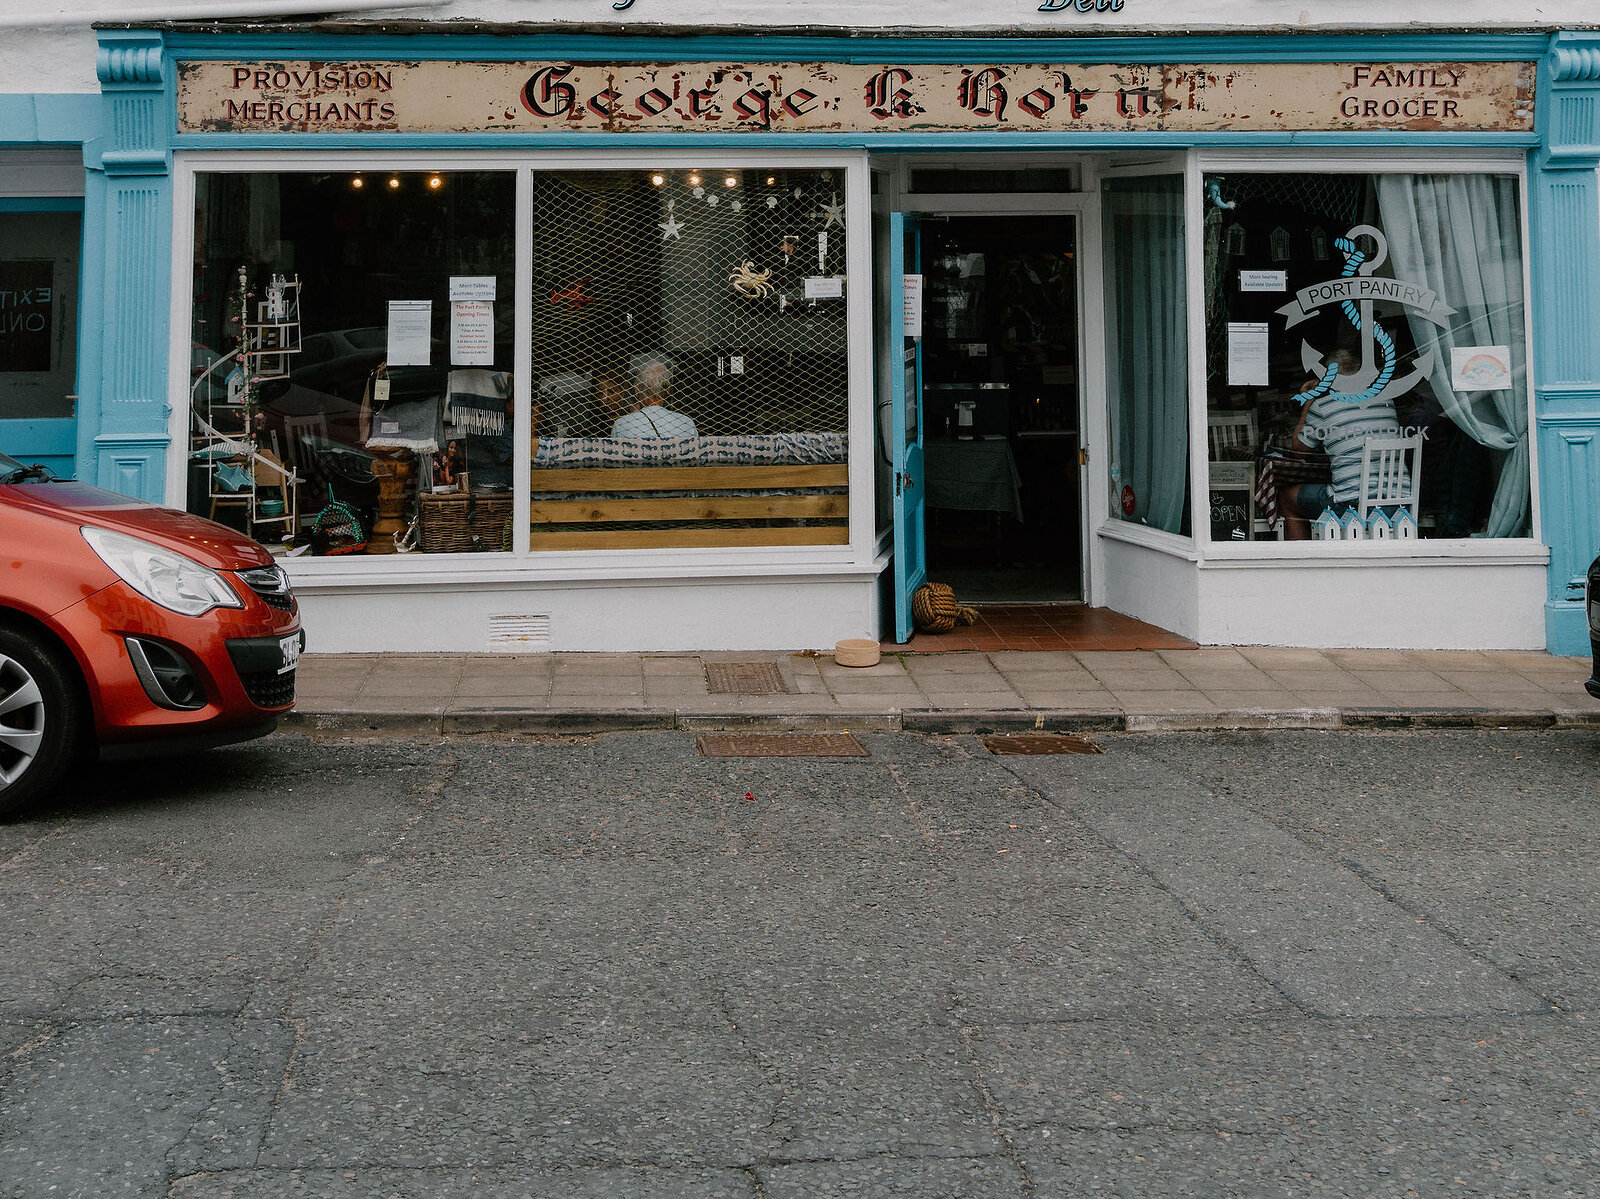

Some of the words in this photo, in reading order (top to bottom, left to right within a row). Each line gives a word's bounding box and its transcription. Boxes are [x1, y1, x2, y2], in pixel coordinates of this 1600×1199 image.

[232, 67, 393, 90] PROVISION
[1352, 66, 1466, 88] FAMILY
[520, 66, 819, 130] George
[226, 99, 396, 122] MERCHANTS
[1308, 281, 1354, 303] PORT
[1360, 280, 1427, 303] PANTRY
